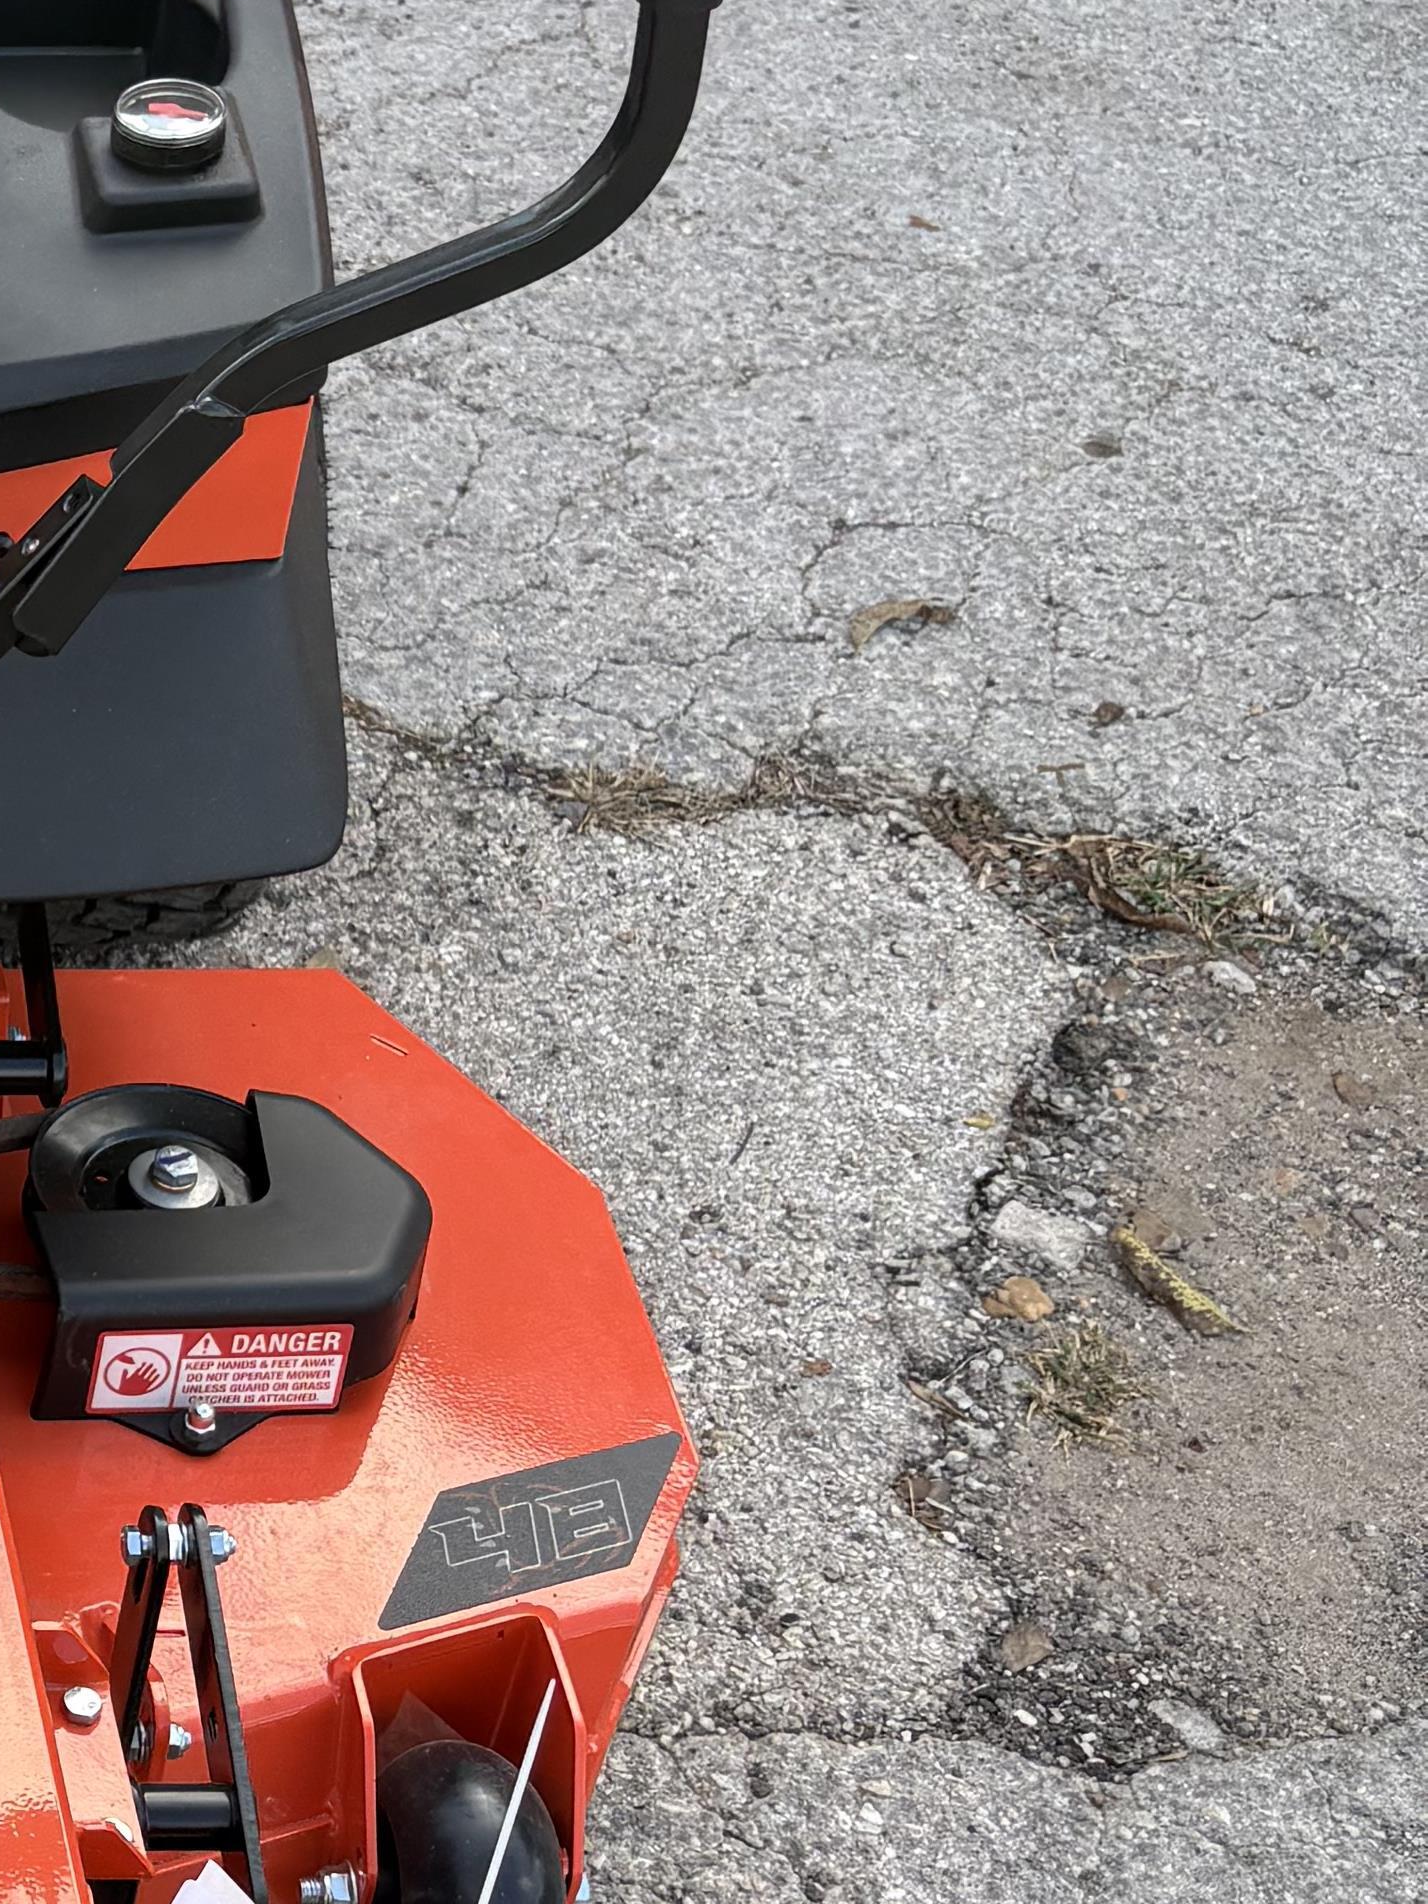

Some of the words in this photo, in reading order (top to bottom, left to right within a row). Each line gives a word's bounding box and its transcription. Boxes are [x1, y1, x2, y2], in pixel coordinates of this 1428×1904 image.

[231, 1331, 342, 1355] DANGER
[185, 1360, 214, 1370] KEEP
[217, 1360, 257, 1369] HANDS
[260, 1359, 268, 1369] &
[271, 1359, 299, 1368] FEET
[186, 1372, 205, 1382] DO
[208, 1372, 230, 1381] NOT
[233, 1371, 283, 1381] OPERATE
[286, 1370, 331, 1380] MOWER
[182, 1384, 226, 1394] UNLESS
[229, 1383, 270, 1393] GUARD
[272, 1383, 289, 1392] OR
[291, 1381, 331, 1391] GRASS
[244, 1394, 255, 1403] IS
[257, 1392, 319, 1403] ATTACHED.
[428, 1478, 633, 1574] 48
